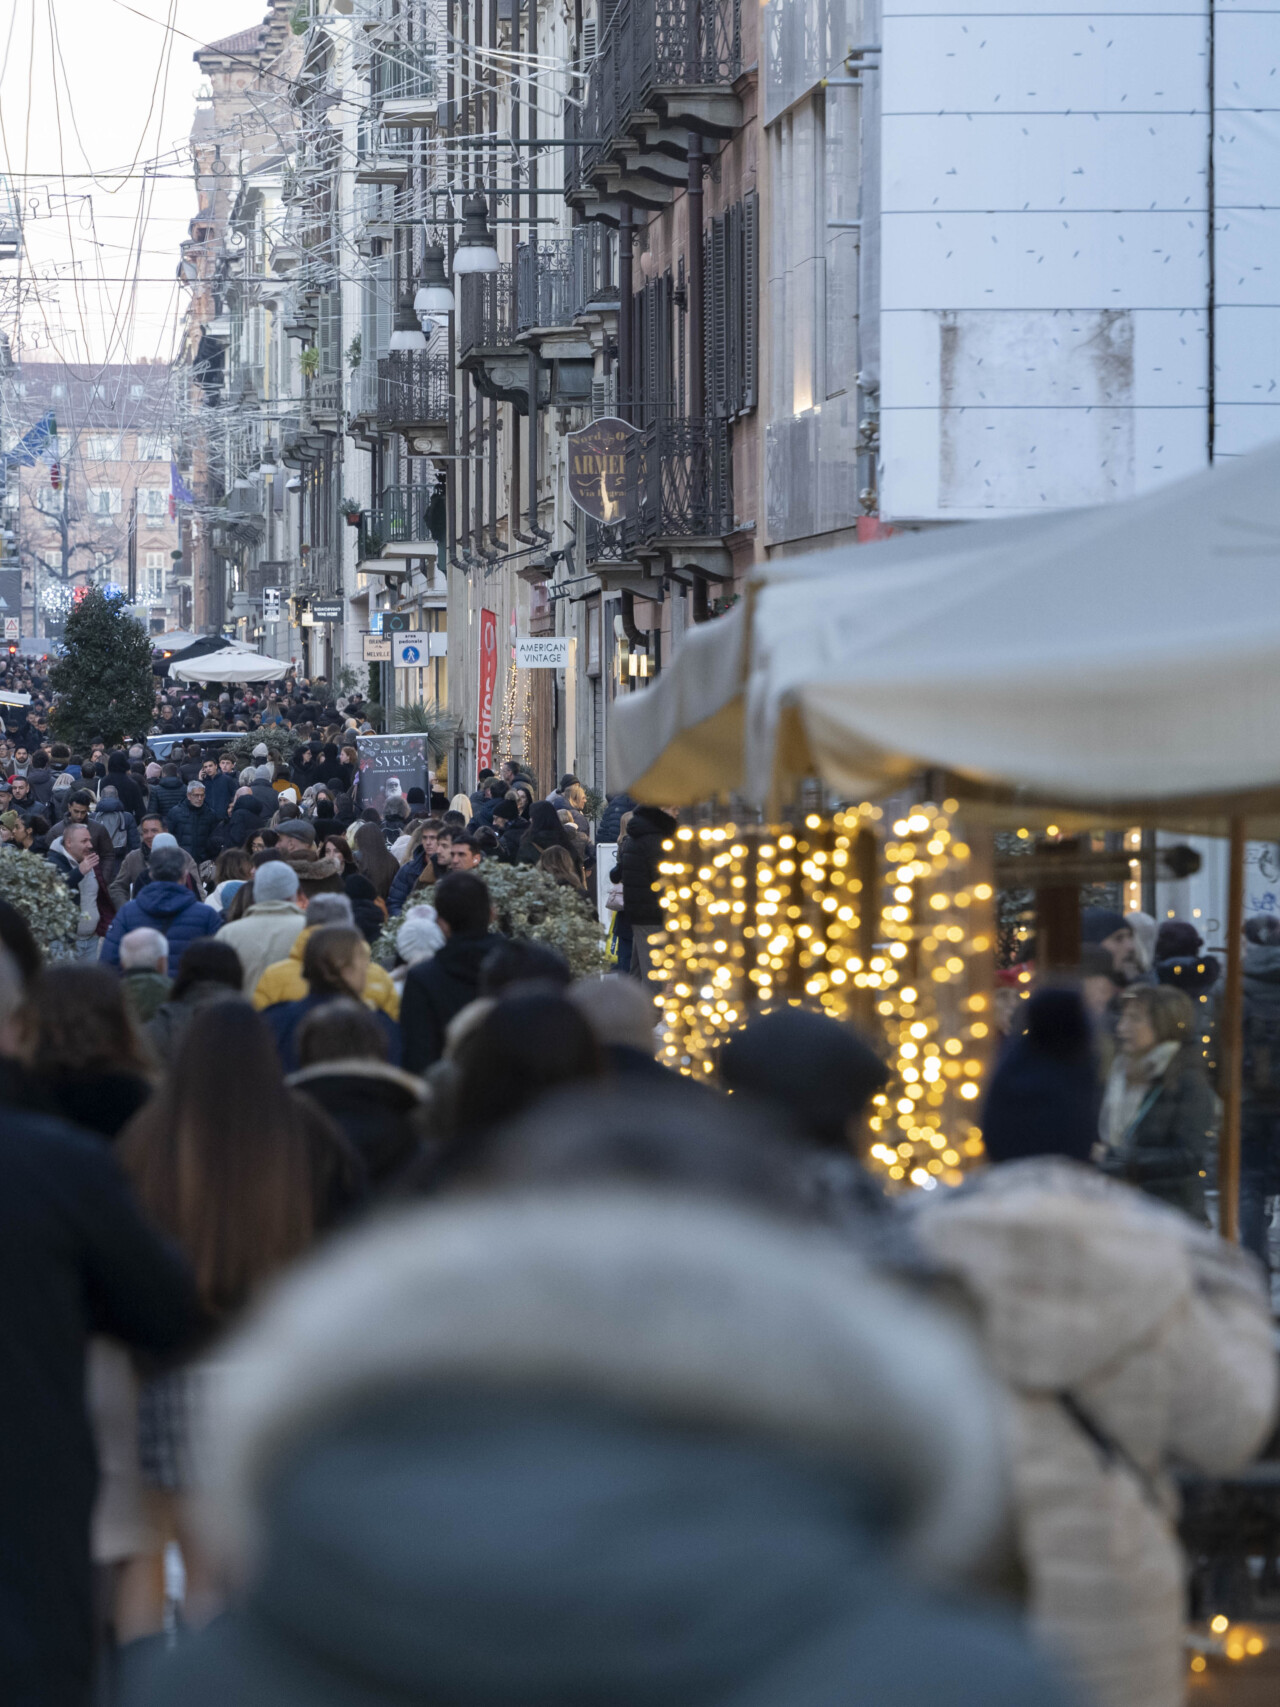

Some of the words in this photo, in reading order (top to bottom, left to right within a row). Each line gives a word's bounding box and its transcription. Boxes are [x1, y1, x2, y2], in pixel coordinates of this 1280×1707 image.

[520, 643, 566, 652] AMERICAN
[524, 653, 562, 663] VINTAGE
[375, 755, 411, 767] SYSE
